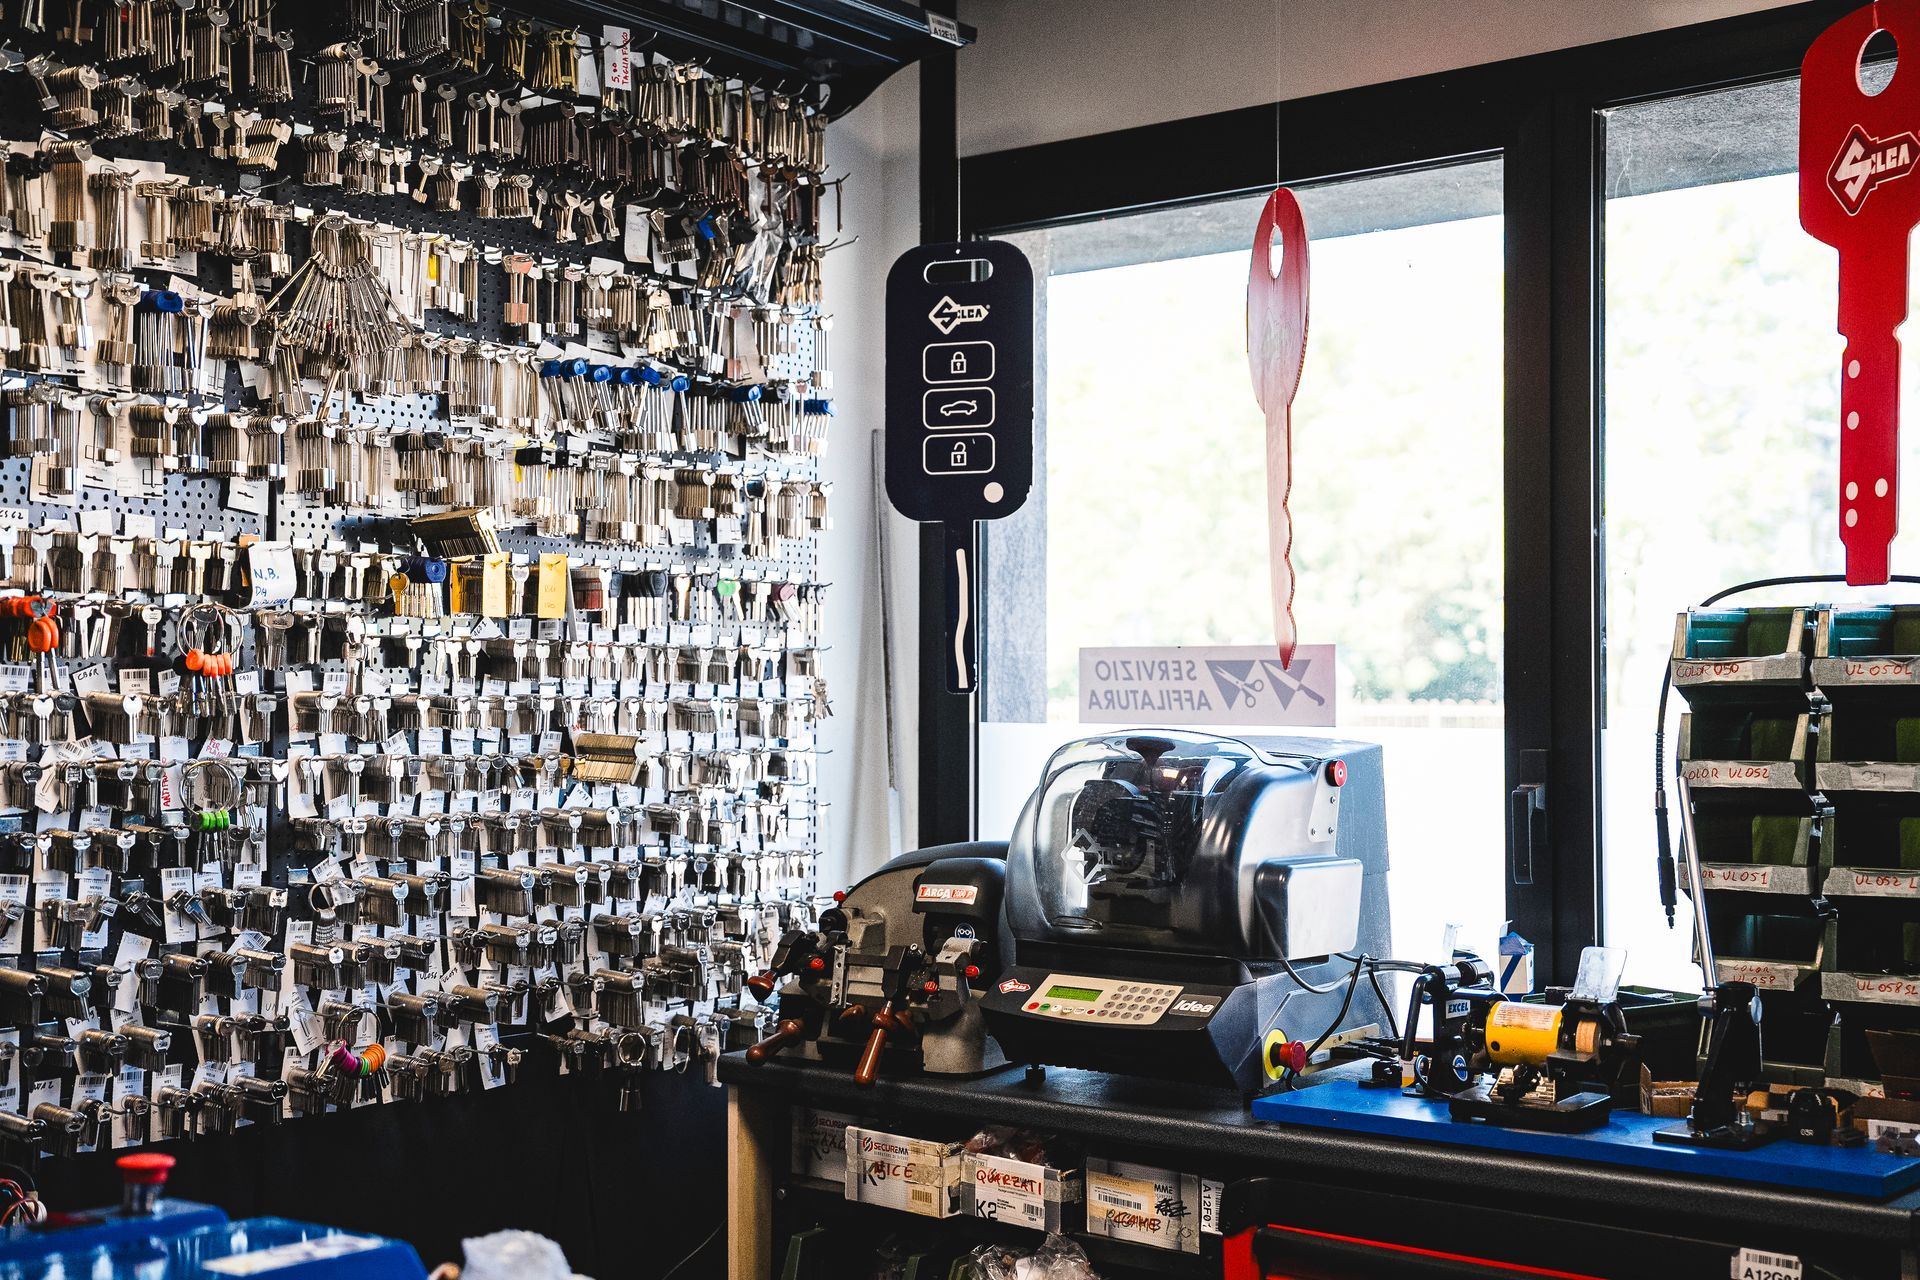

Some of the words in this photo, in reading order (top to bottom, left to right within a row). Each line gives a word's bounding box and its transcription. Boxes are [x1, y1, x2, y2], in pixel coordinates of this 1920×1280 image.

[1834, 137, 1911, 203] SILCA
[932, 301, 983, 330] SILCA
[920, 885, 951, 899] TARGA
[1173, 998, 1215, 1014] Idea
[1447, 1001, 1469, 1014] EXCEL
[976, 1198, 998, 1221] K2
